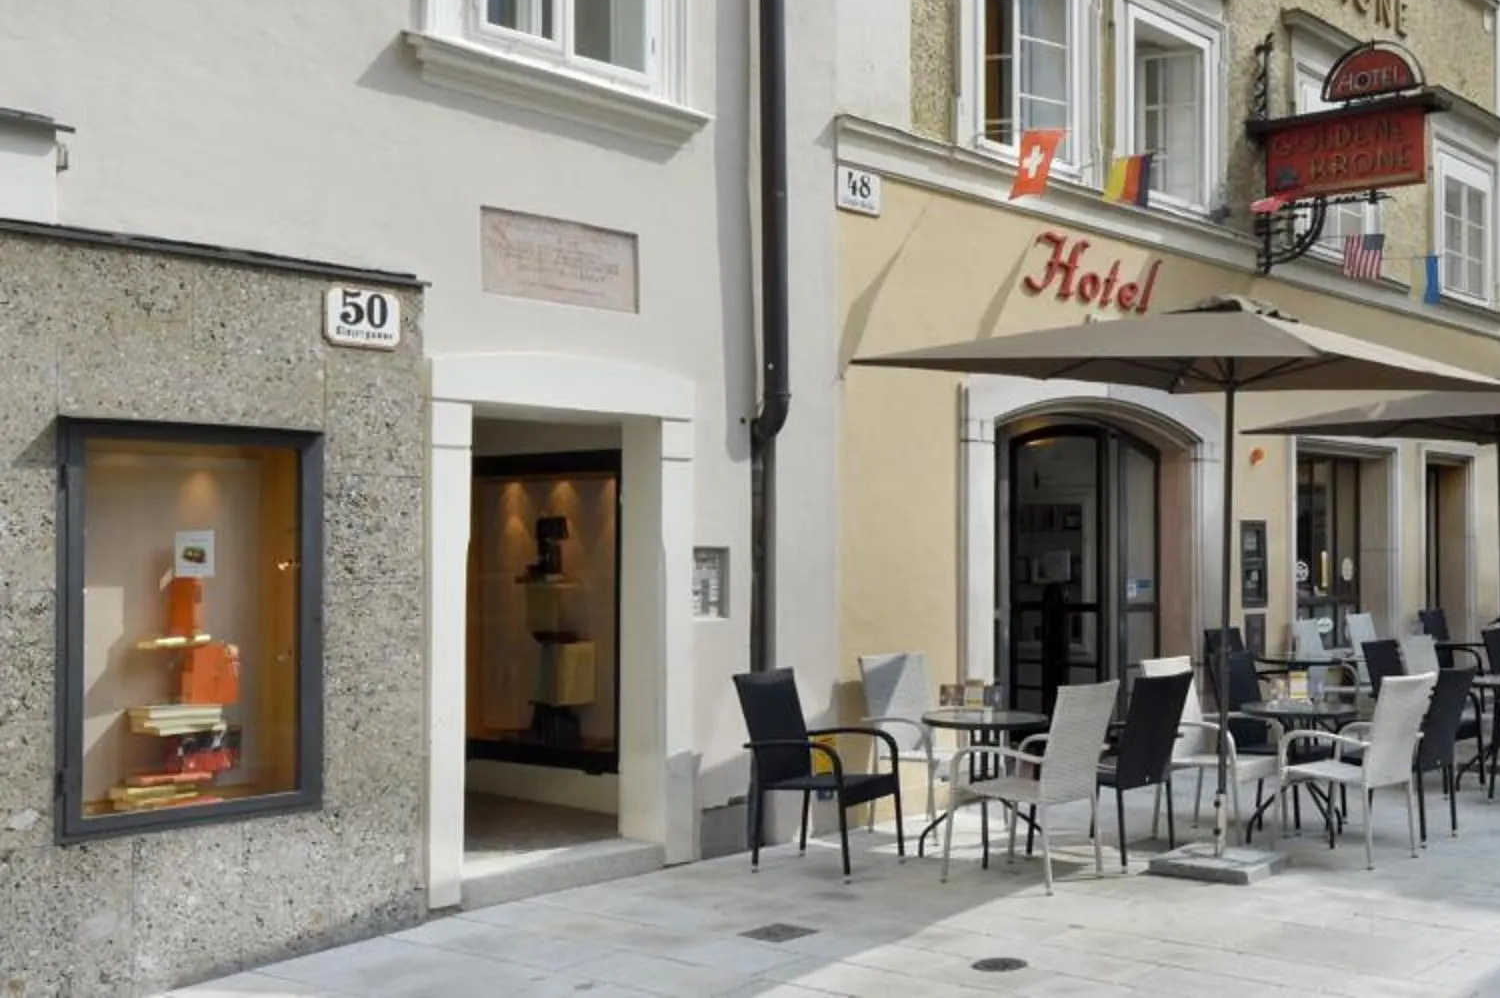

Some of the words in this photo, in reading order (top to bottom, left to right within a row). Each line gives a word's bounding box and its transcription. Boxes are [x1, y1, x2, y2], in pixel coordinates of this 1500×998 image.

[1336, 65, 1407, 92] HOTEL
[1273, 116, 1404, 156] GOLDENE
[1310, 144, 1412, 181] KRONE
[847, 171, 871, 199] 48
[1023, 231, 1163, 315] Hotel
[340, 289, 388, 329] 50
